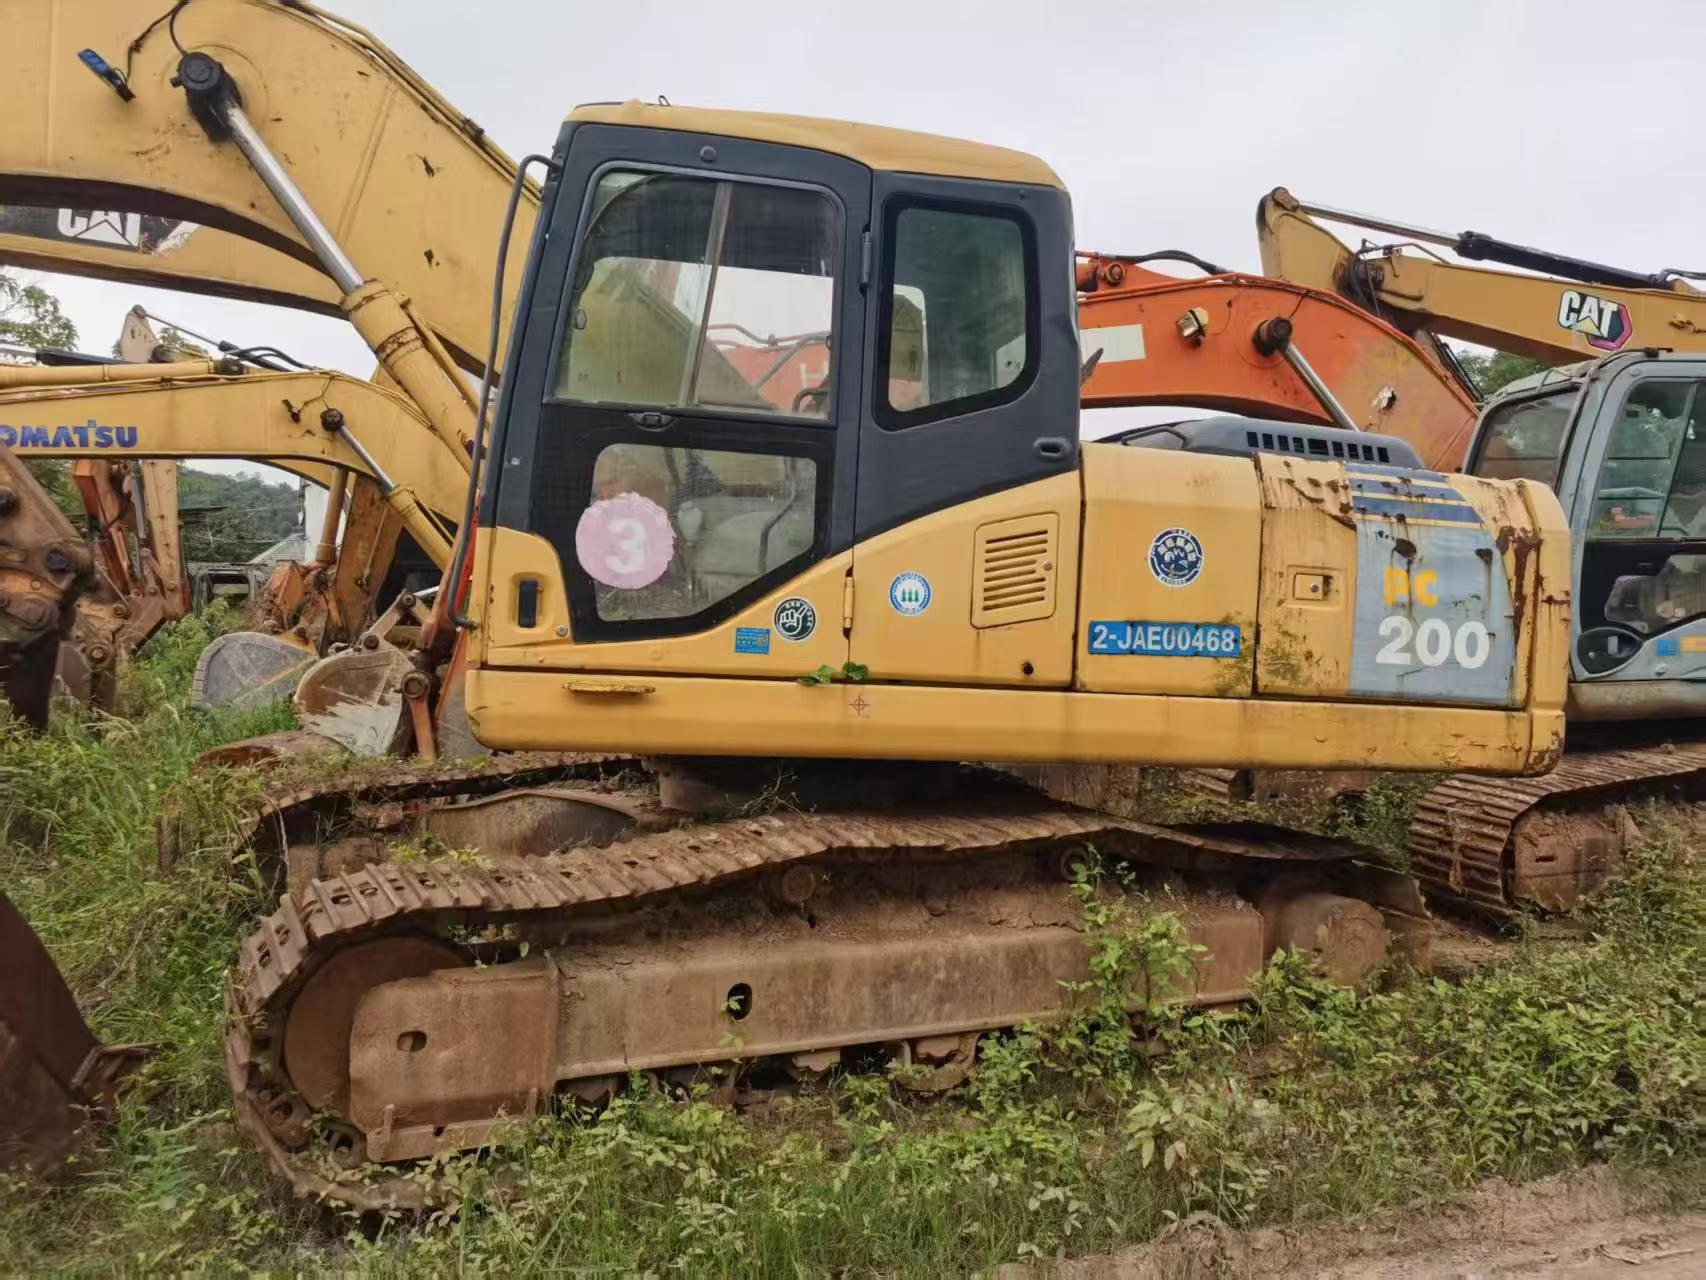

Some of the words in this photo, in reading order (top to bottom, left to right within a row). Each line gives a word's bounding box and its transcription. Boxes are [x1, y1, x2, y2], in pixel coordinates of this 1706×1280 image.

[1559, 290, 1619, 338] CAT
[605, 517, 646, 574] 3
[1383, 566, 1440, 607] PC
[1093, 624, 1235, 652] 2-JAE00468
[1375, 615, 1490, 669] 200
